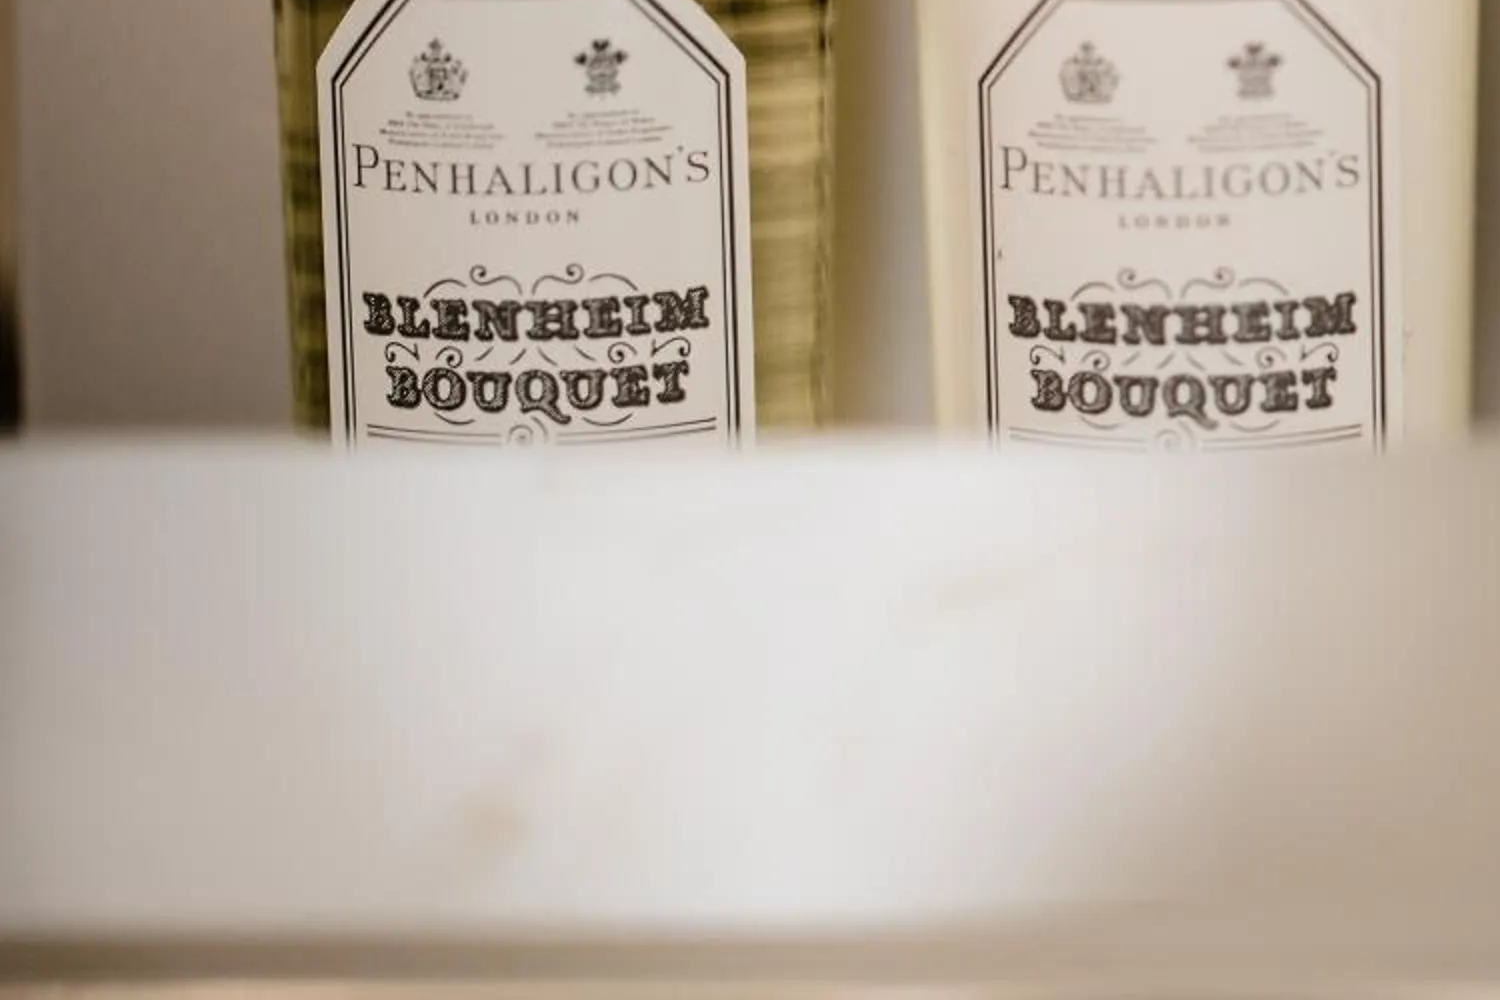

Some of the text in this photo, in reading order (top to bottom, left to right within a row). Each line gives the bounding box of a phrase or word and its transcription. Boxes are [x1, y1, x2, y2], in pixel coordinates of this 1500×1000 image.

[352, 144, 710, 196] PENHALIGON'S
[999, 145, 1360, 201] PENHALIGON'S
[470, 209, 580, 225] LONDON
[363, 286, 710, 341] BLENHEIM
[1008, 292, 1357, 345] BLENHEIM
[386, 361, 689, 425] BOUQUET
[1030, 367, 1338, 430] BOUQUET
